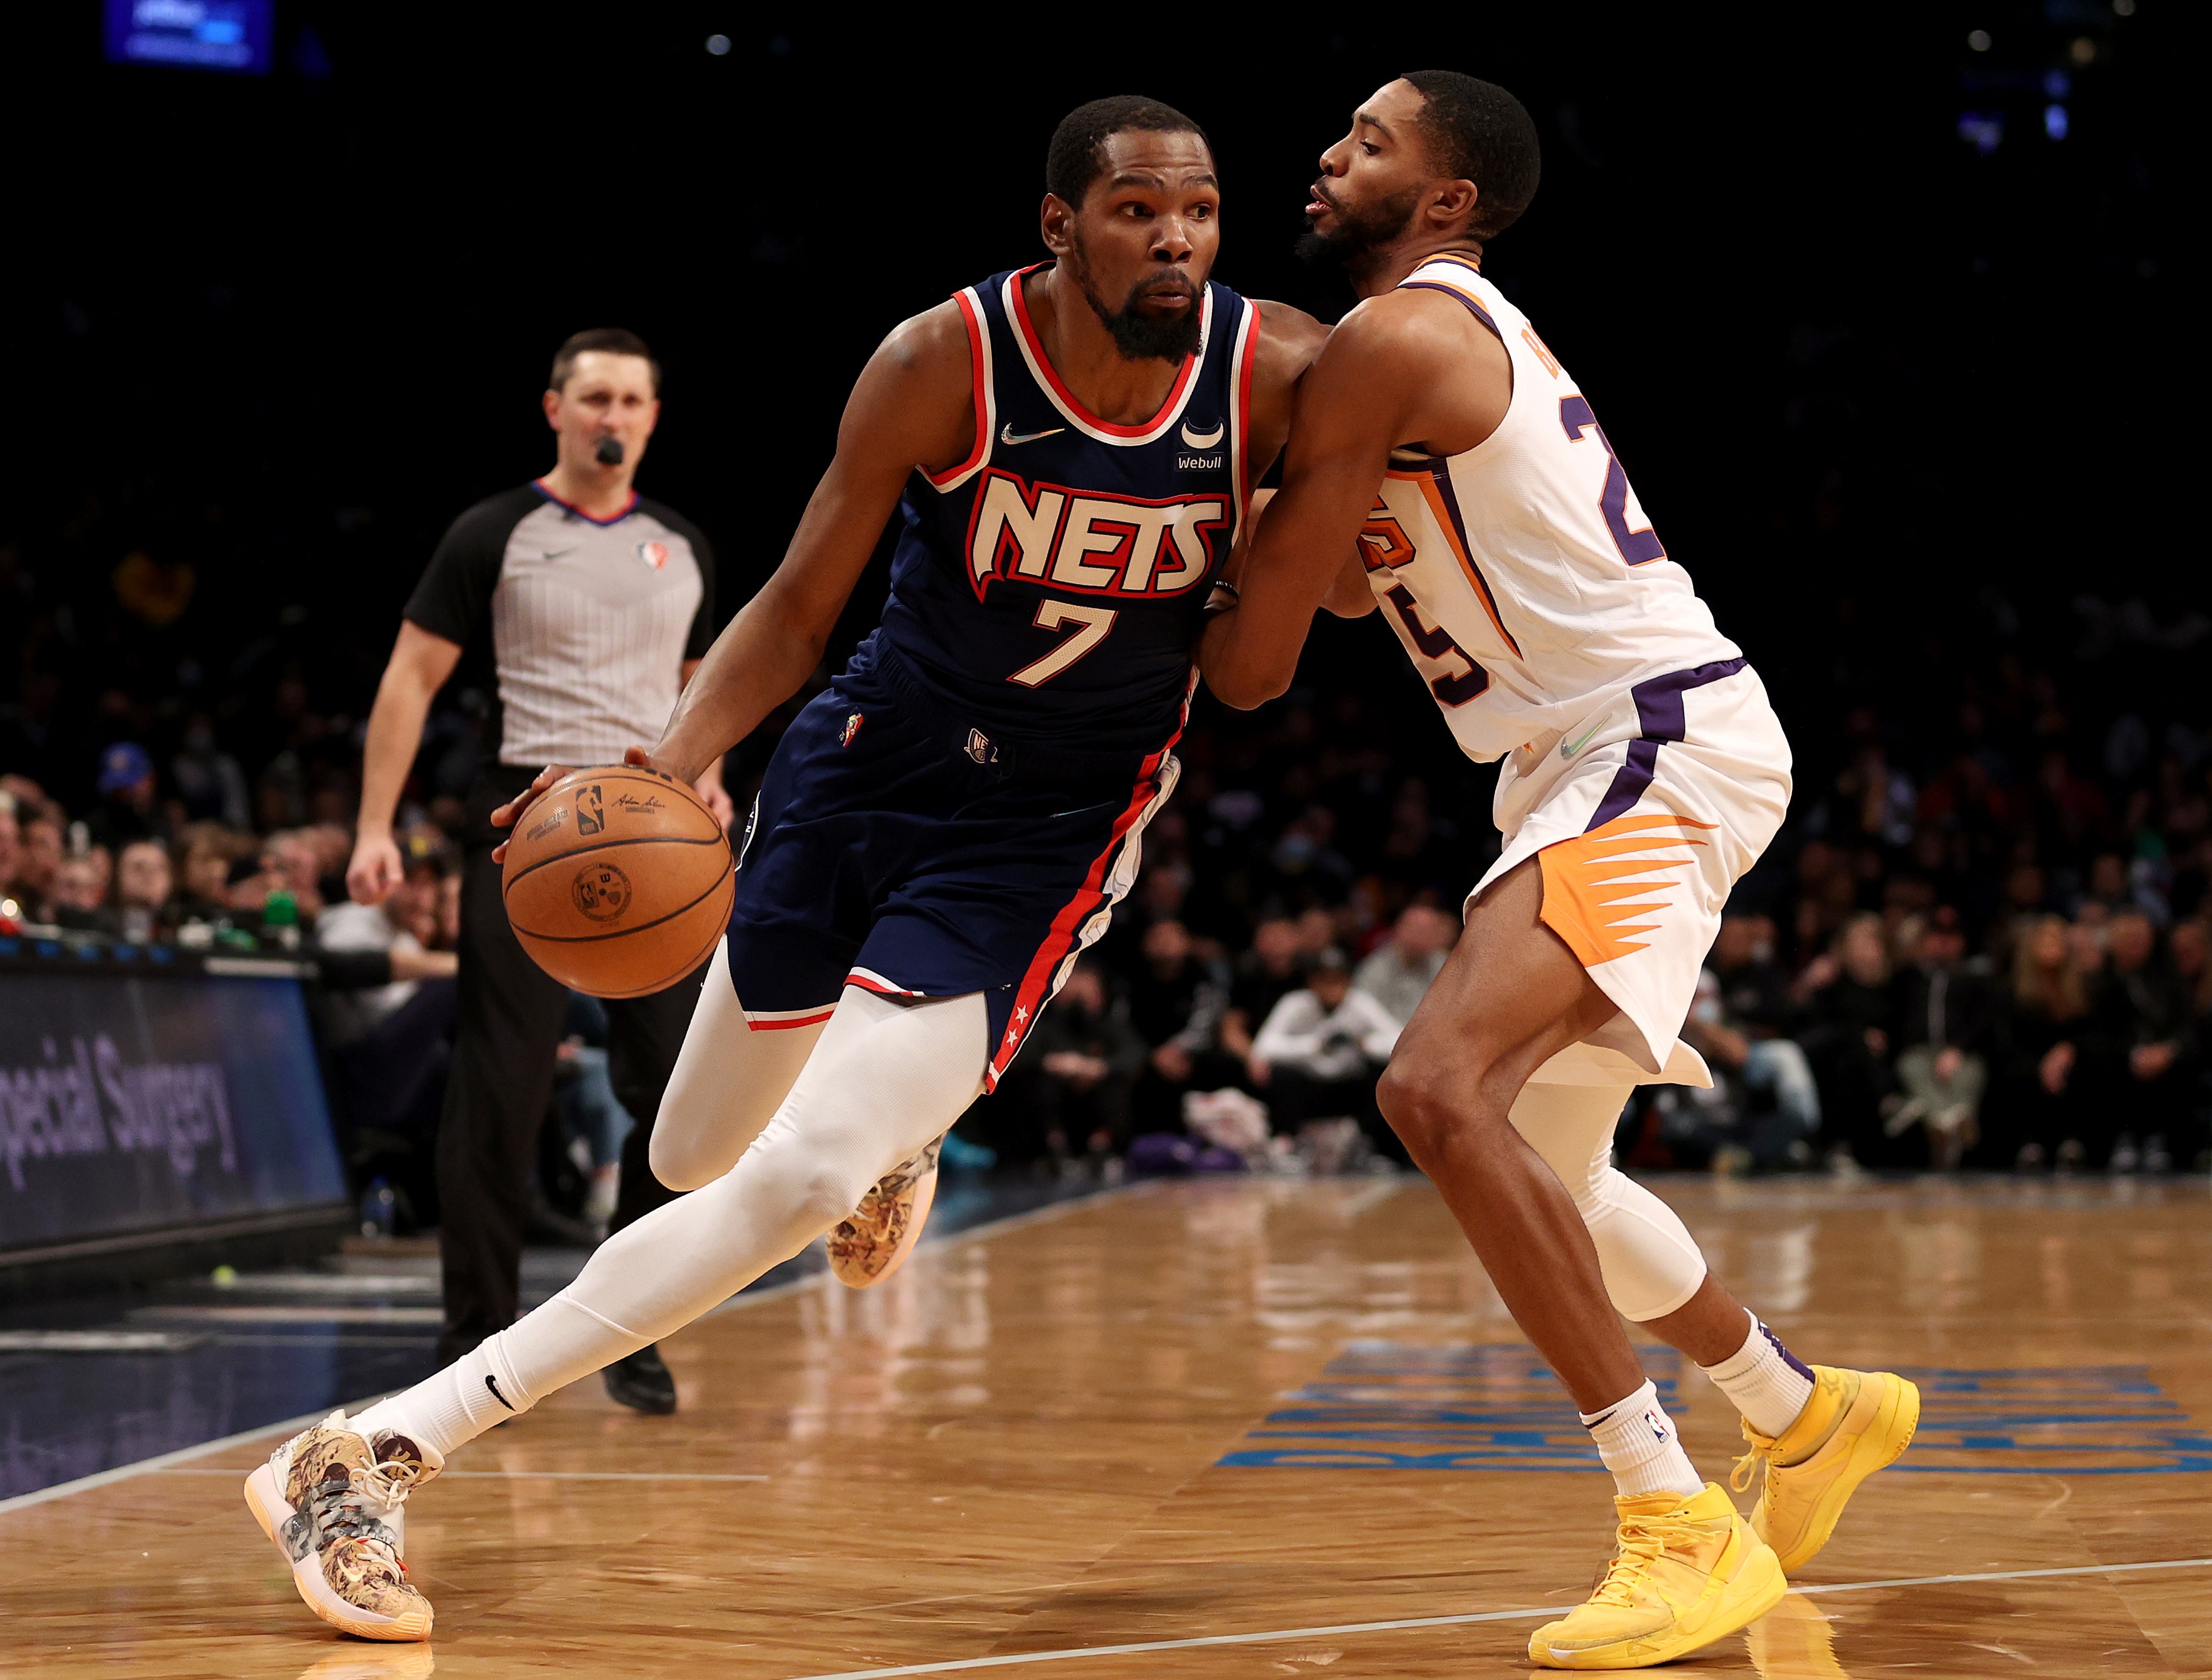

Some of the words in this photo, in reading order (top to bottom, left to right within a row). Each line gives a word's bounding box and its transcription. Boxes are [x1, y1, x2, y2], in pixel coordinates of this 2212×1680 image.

[1178, 456, 1221, 469] Webull
[966, 466, 1229, 603] NETS
[1006, 599, 1118, 688] 7
